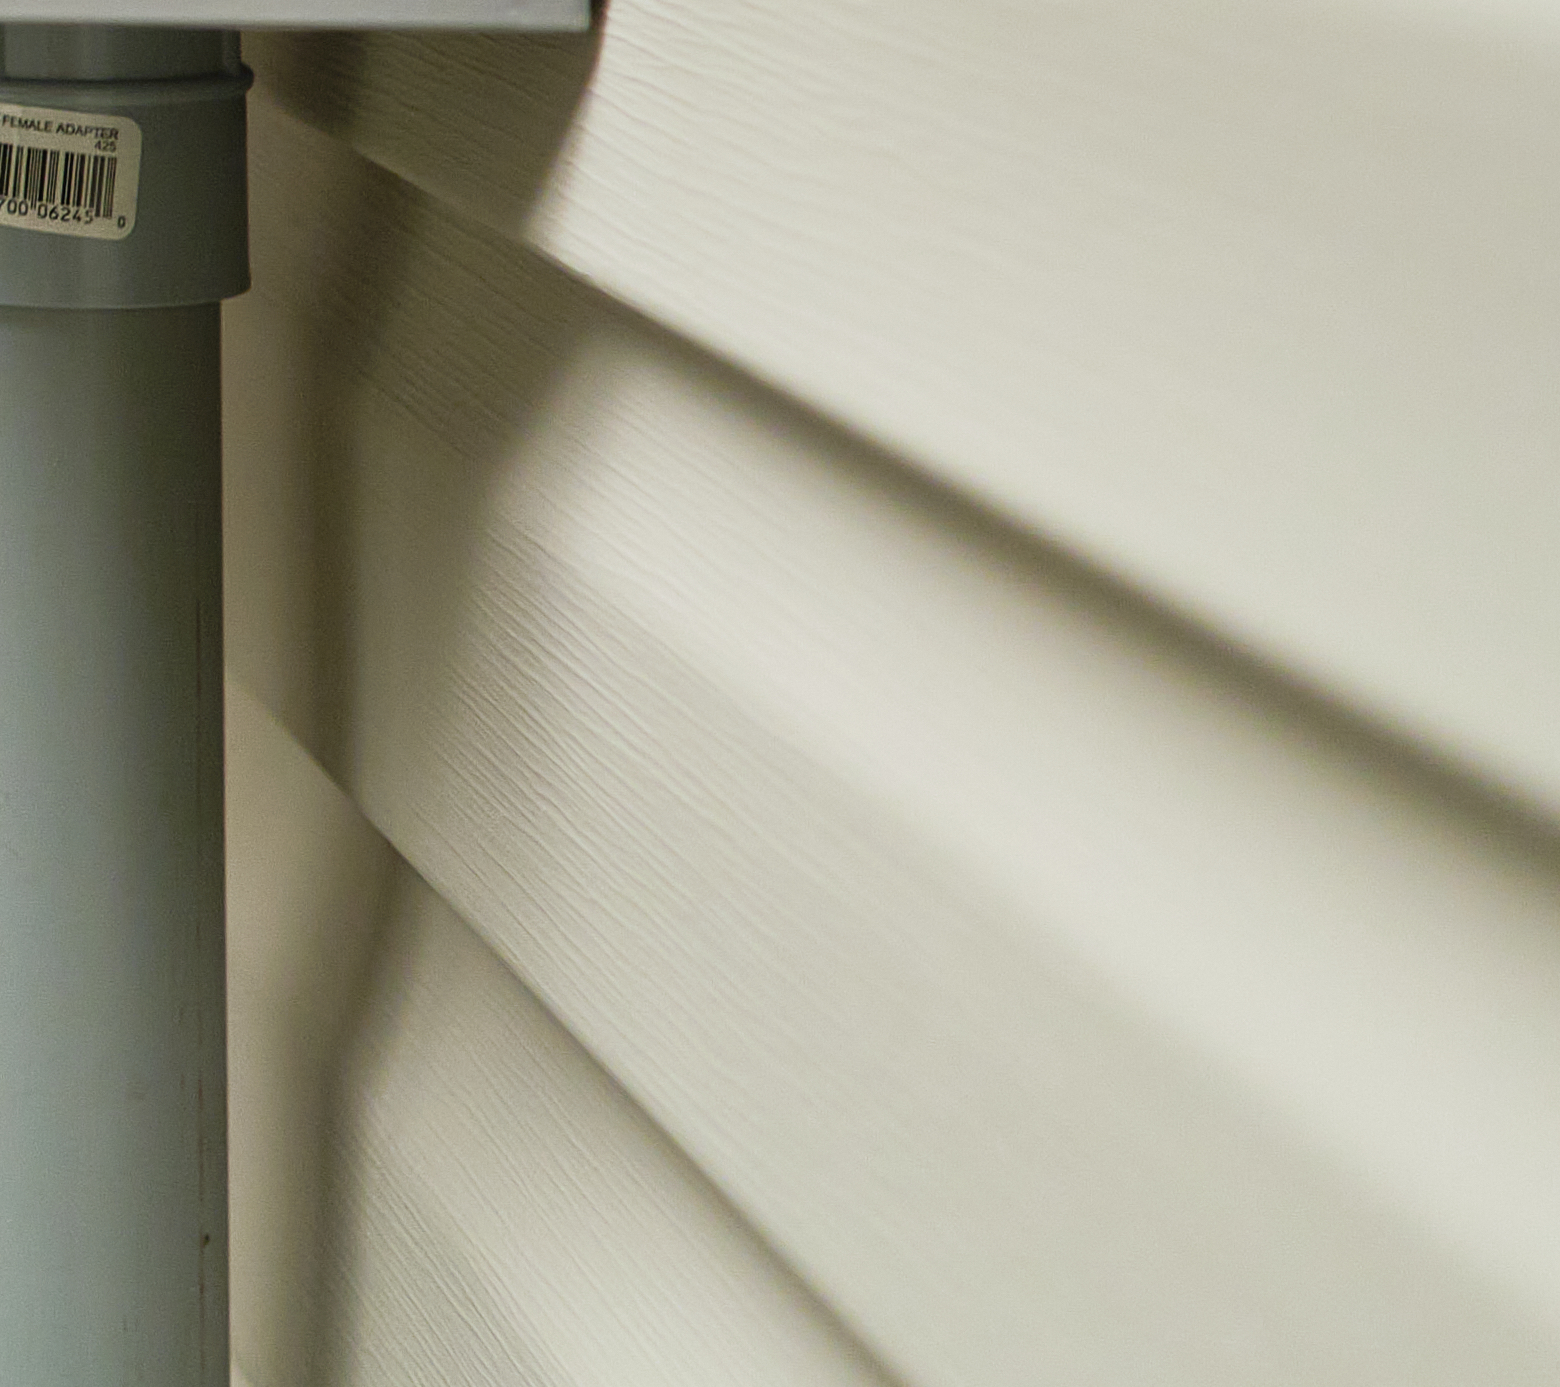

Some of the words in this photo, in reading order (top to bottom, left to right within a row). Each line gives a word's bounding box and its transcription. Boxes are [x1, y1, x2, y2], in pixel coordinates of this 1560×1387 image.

[1, 114, 53, 135] FEMALE
[55, 122, 120, 141] ADAPTER
[37, 203, 95, 225] 06245
[117, 215, 127, 229] 0
